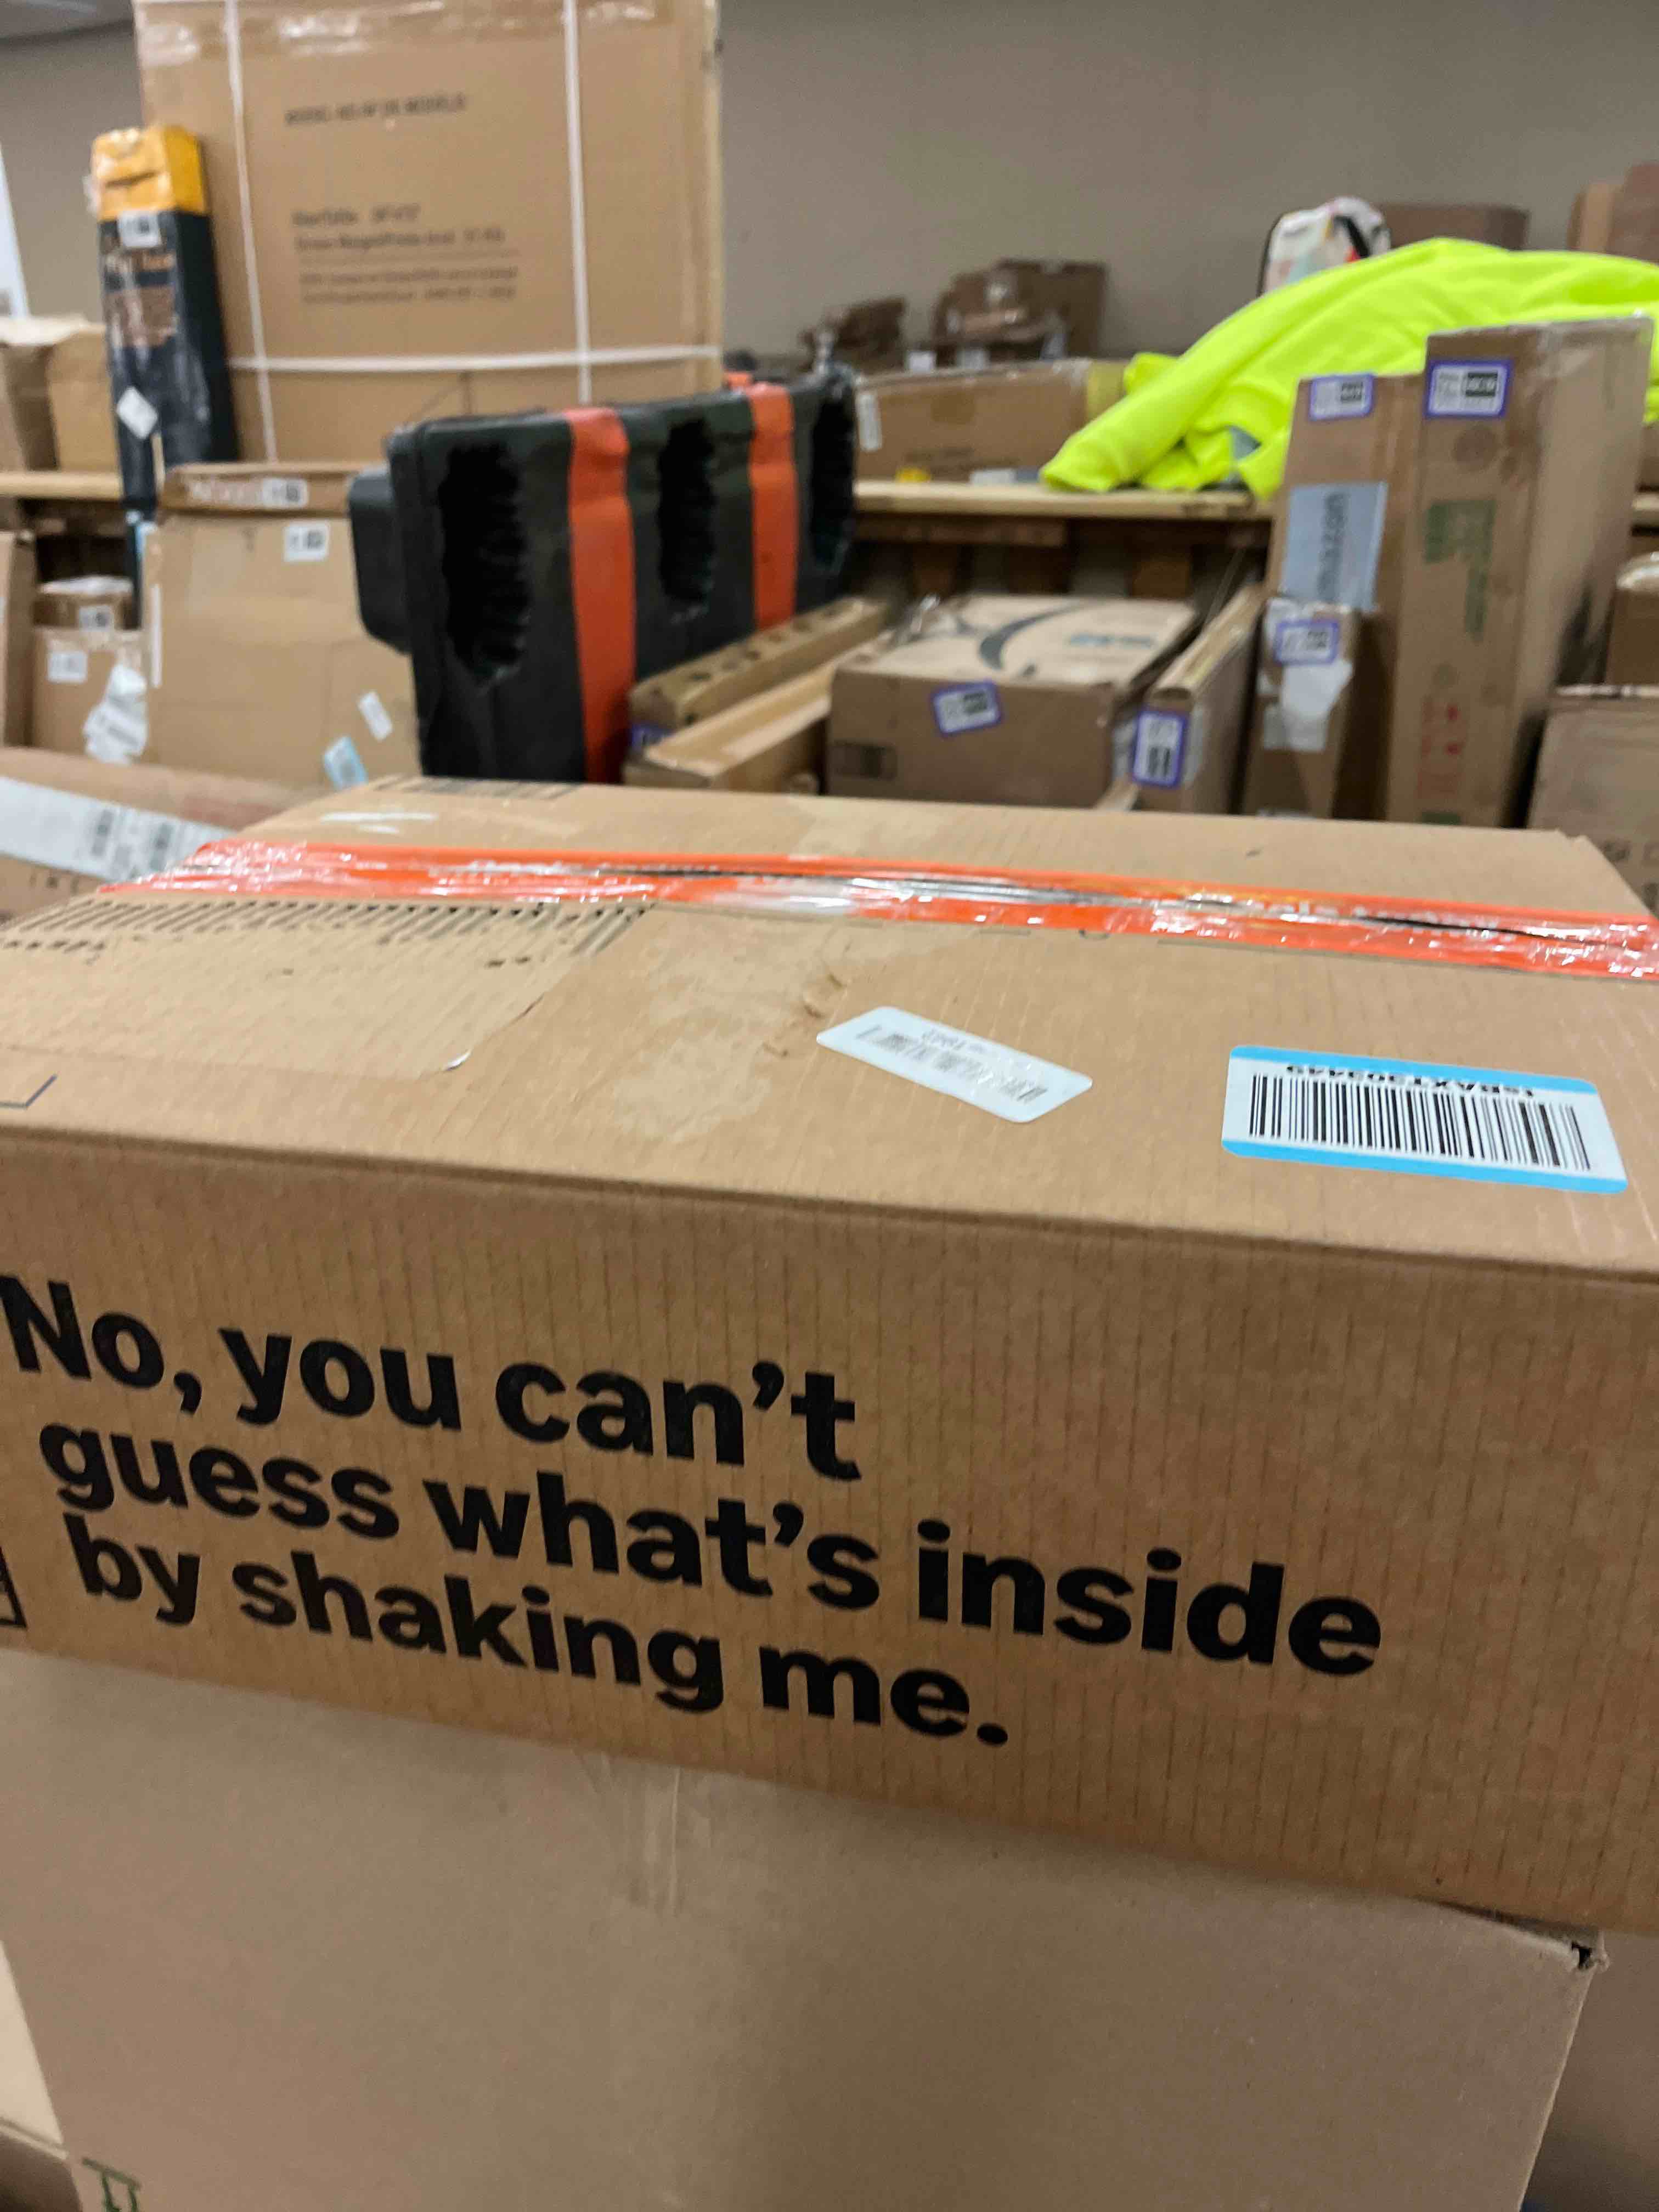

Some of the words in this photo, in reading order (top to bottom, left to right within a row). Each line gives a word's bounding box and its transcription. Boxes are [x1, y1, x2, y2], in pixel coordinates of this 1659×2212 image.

[0, 1274, 202, 1415] No,
[218, 1328, 461, 1432] you
[495, 1361, 862, 1483] can’t
[39, 1423, 399, 1540] guess
[422, 1470, 881, 1612] what’s
[917, 1518, 1381, 1679] inside
[63, 1511, 200, 1627] by
[232, 1550, 725, 1715] shaking
[758, 1644, 1009, 1749] me.
